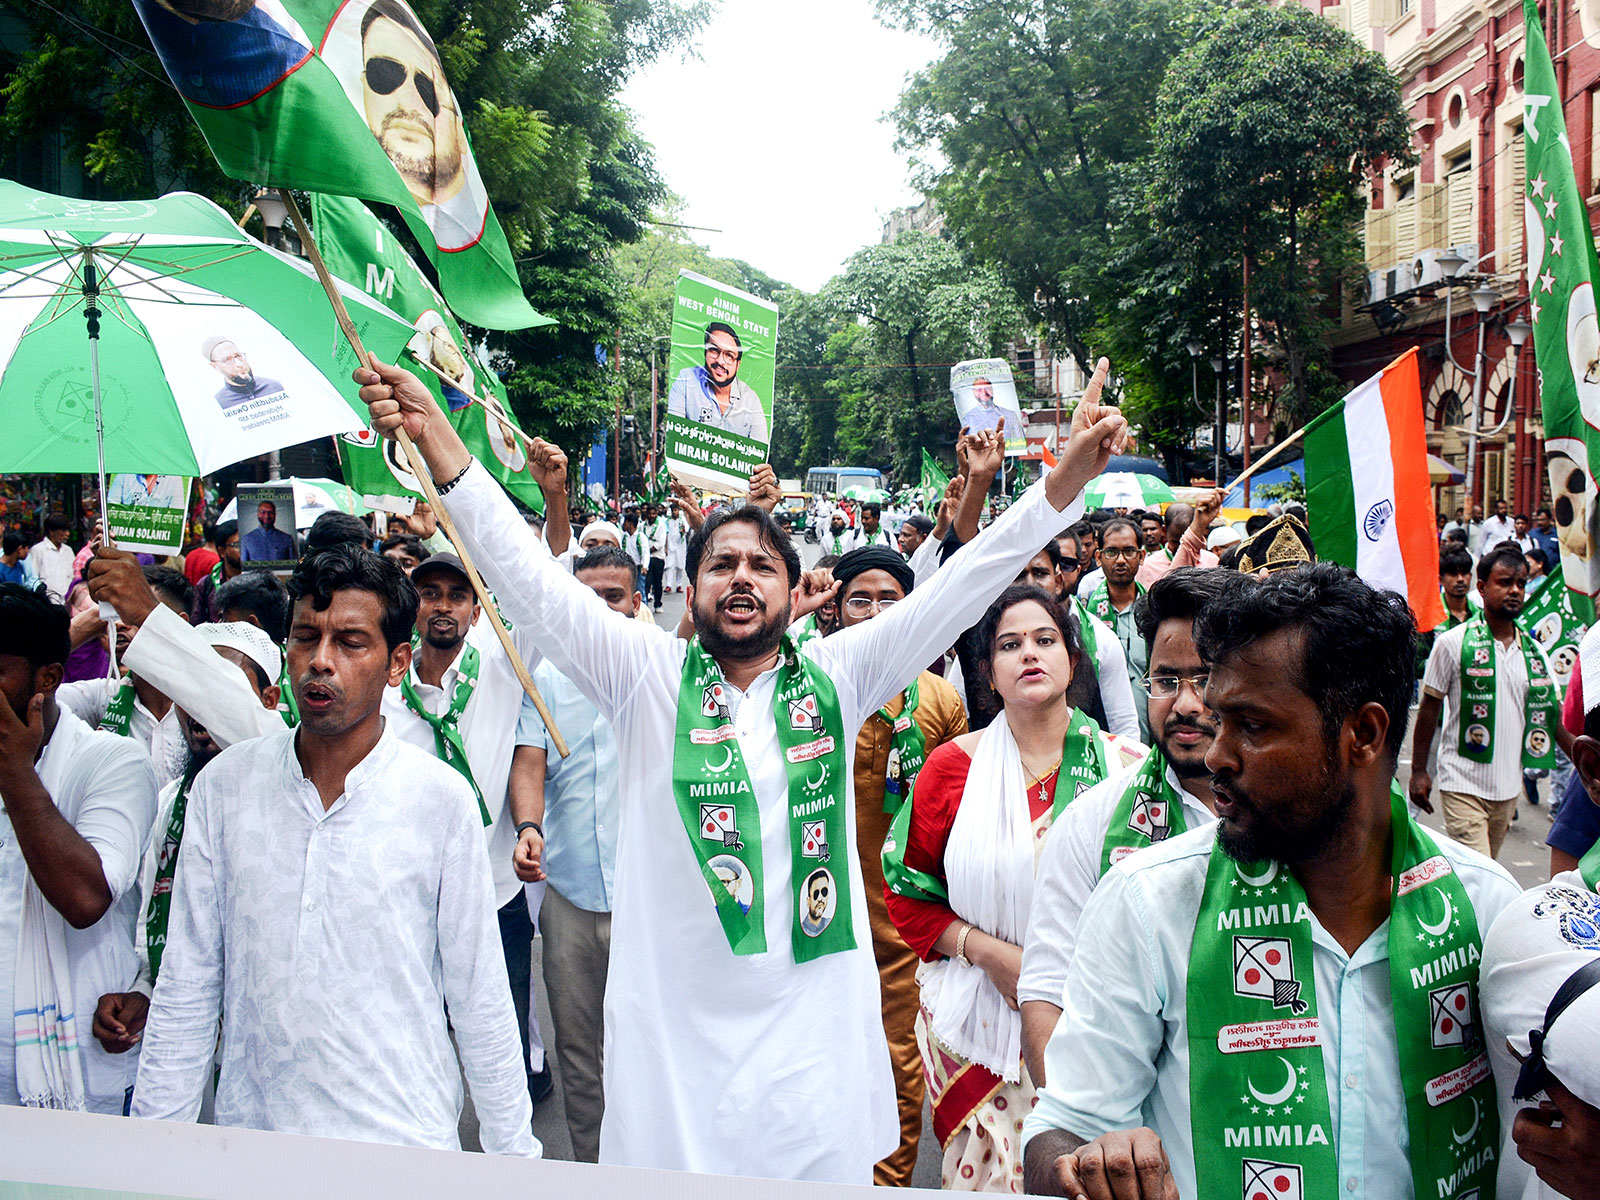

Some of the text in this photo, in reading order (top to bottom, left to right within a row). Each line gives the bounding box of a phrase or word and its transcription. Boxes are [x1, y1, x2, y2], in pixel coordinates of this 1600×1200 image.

[678, 295, 770, 337] WEST BENGAL STATE
[712, 297, 740, 314] AIMIM
[674, 441, 755, 476] IMRAN SOLANKI
[136, 527, 171, 541] SOLANKI
